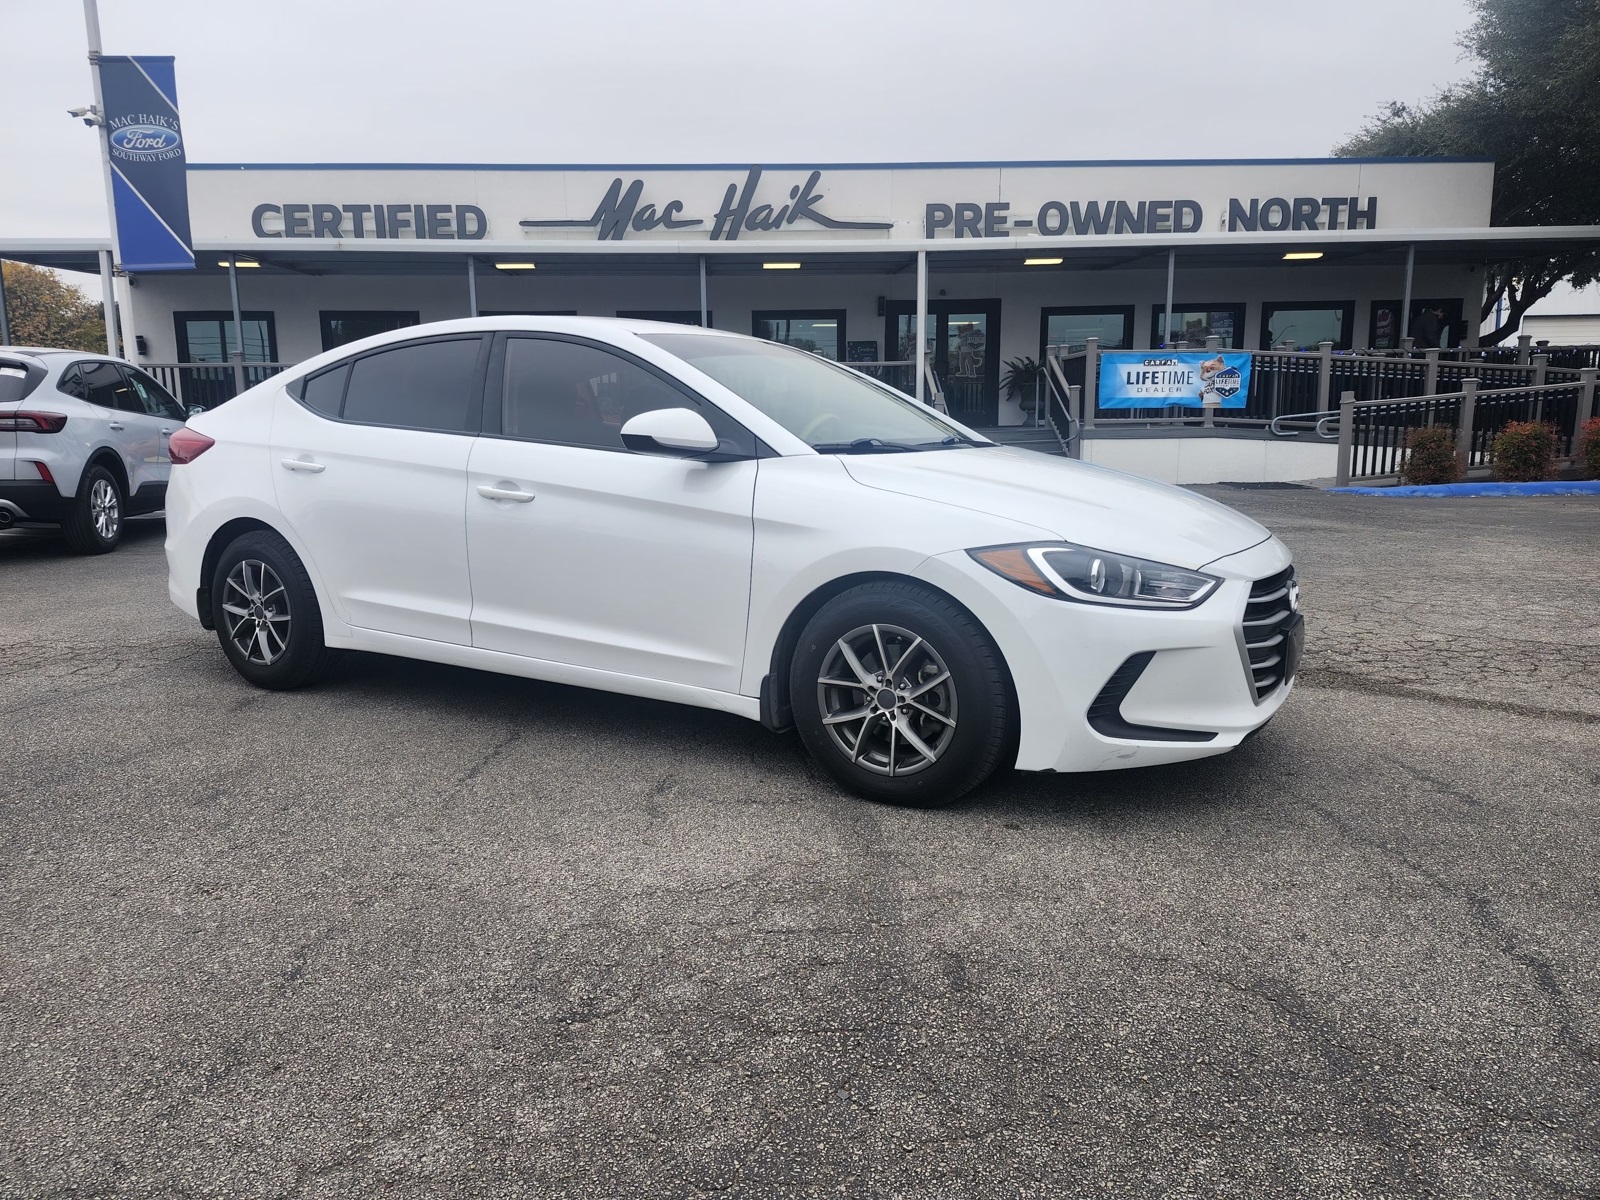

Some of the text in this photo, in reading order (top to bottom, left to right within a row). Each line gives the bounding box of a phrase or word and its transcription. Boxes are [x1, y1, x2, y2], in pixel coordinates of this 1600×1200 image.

[109, 113, 179, 131] MAC HAIK'S
[123, 129, 166, 149] Ford
[111, 148, 182, 162] SOUTHWAY FORD
[251, 164, 1378, 241] CERTIFIED Mac Haik PRE-OWNED NORTH
[1126, 371, 1194, 385] LIFETIME
